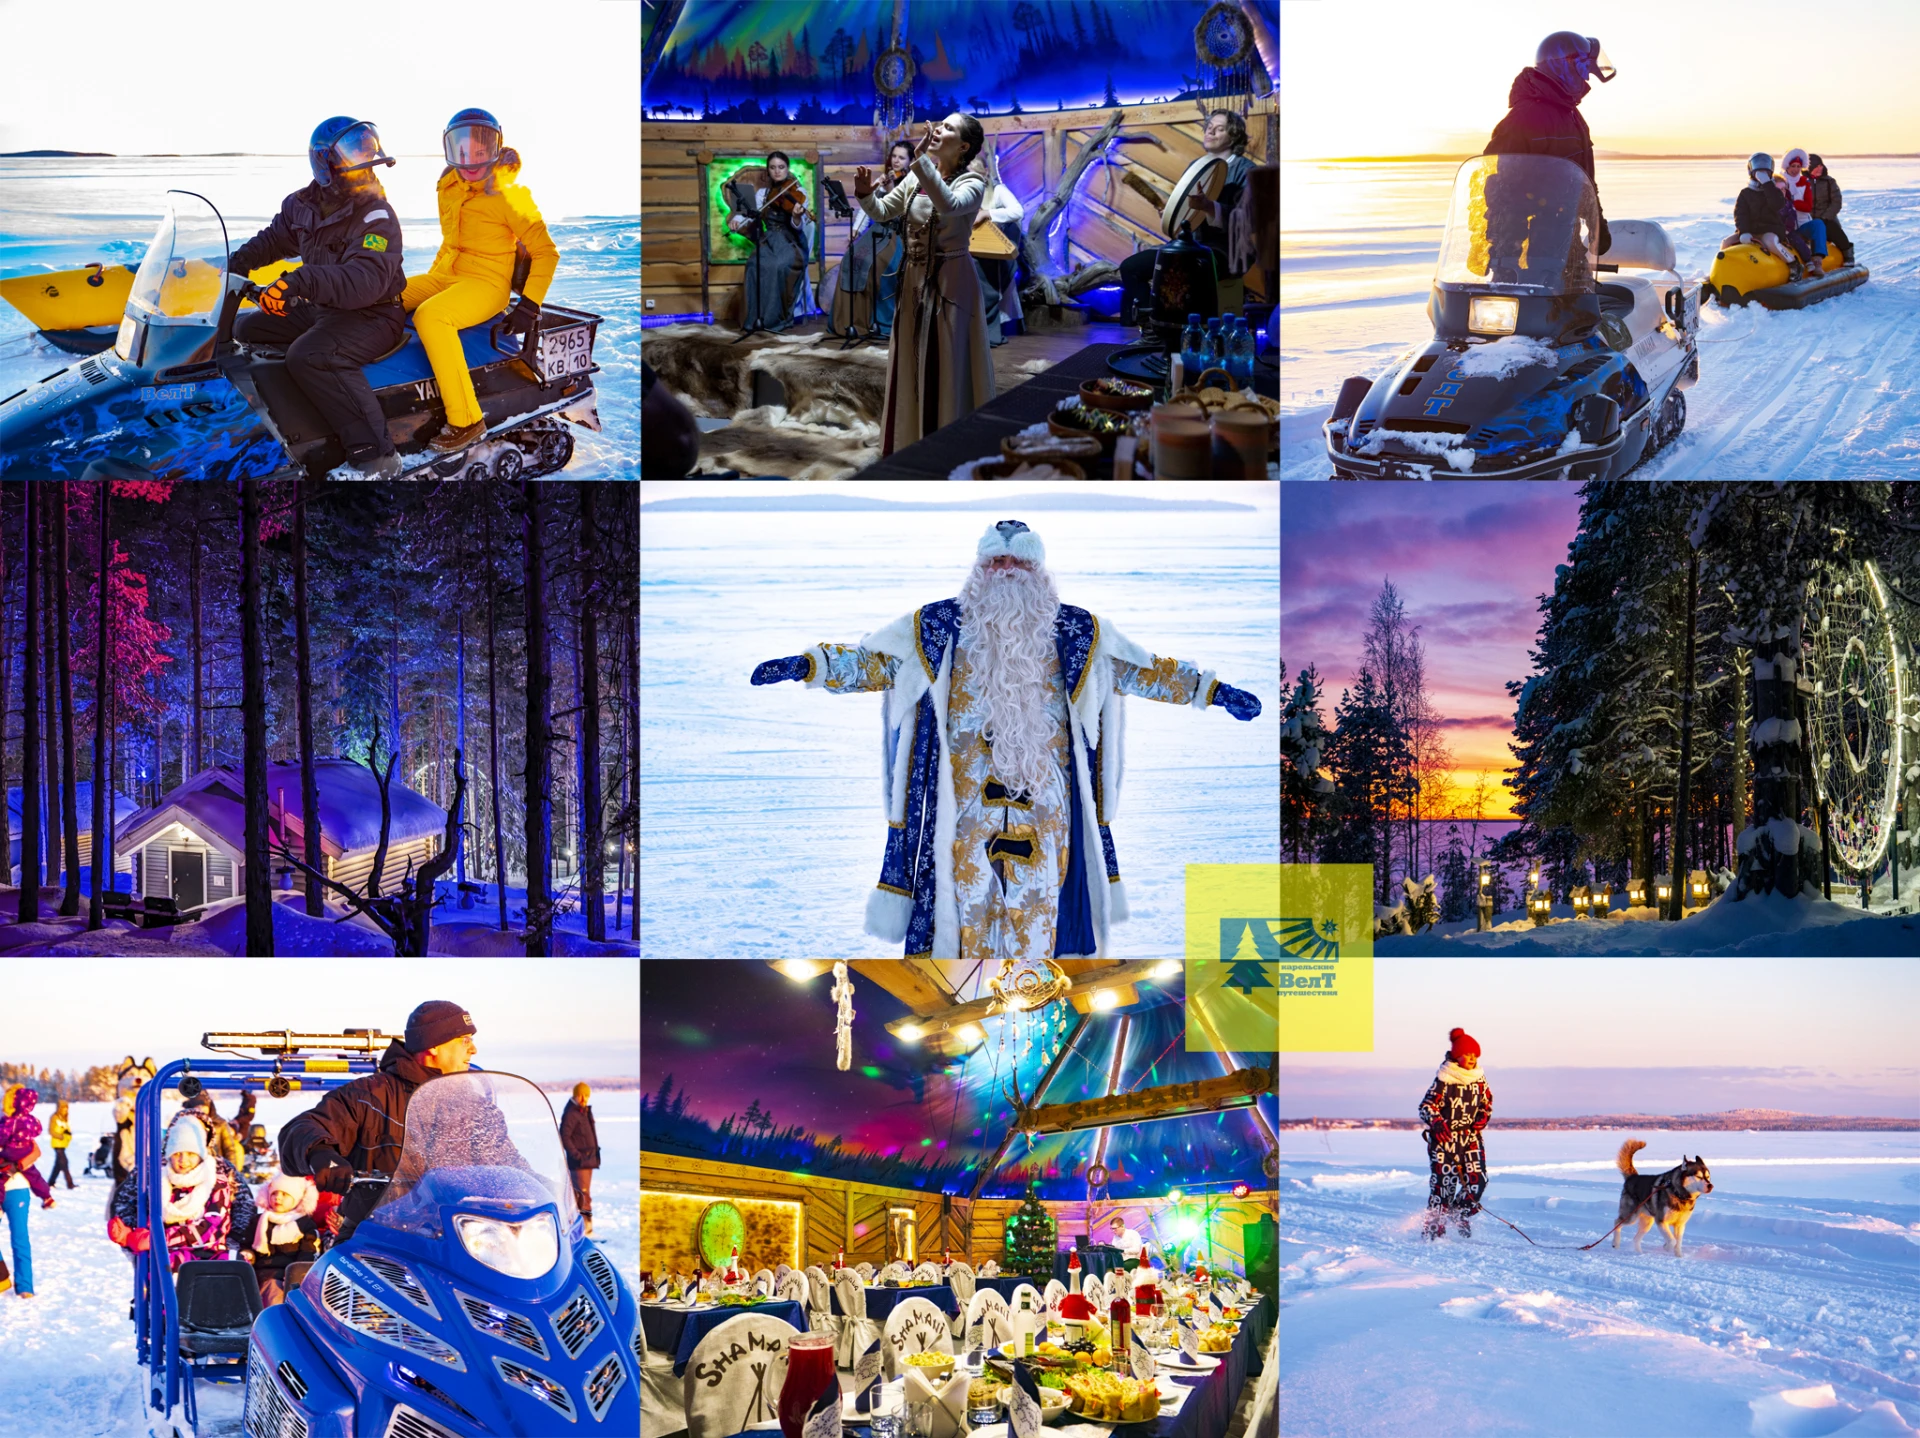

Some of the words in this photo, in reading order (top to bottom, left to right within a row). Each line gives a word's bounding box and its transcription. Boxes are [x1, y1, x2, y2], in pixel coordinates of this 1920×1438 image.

[549, 330, 585, 355] 2965
[573, 354, 588, 368] 10
[1068, 1081, 1200, 1123] SHAMANI
